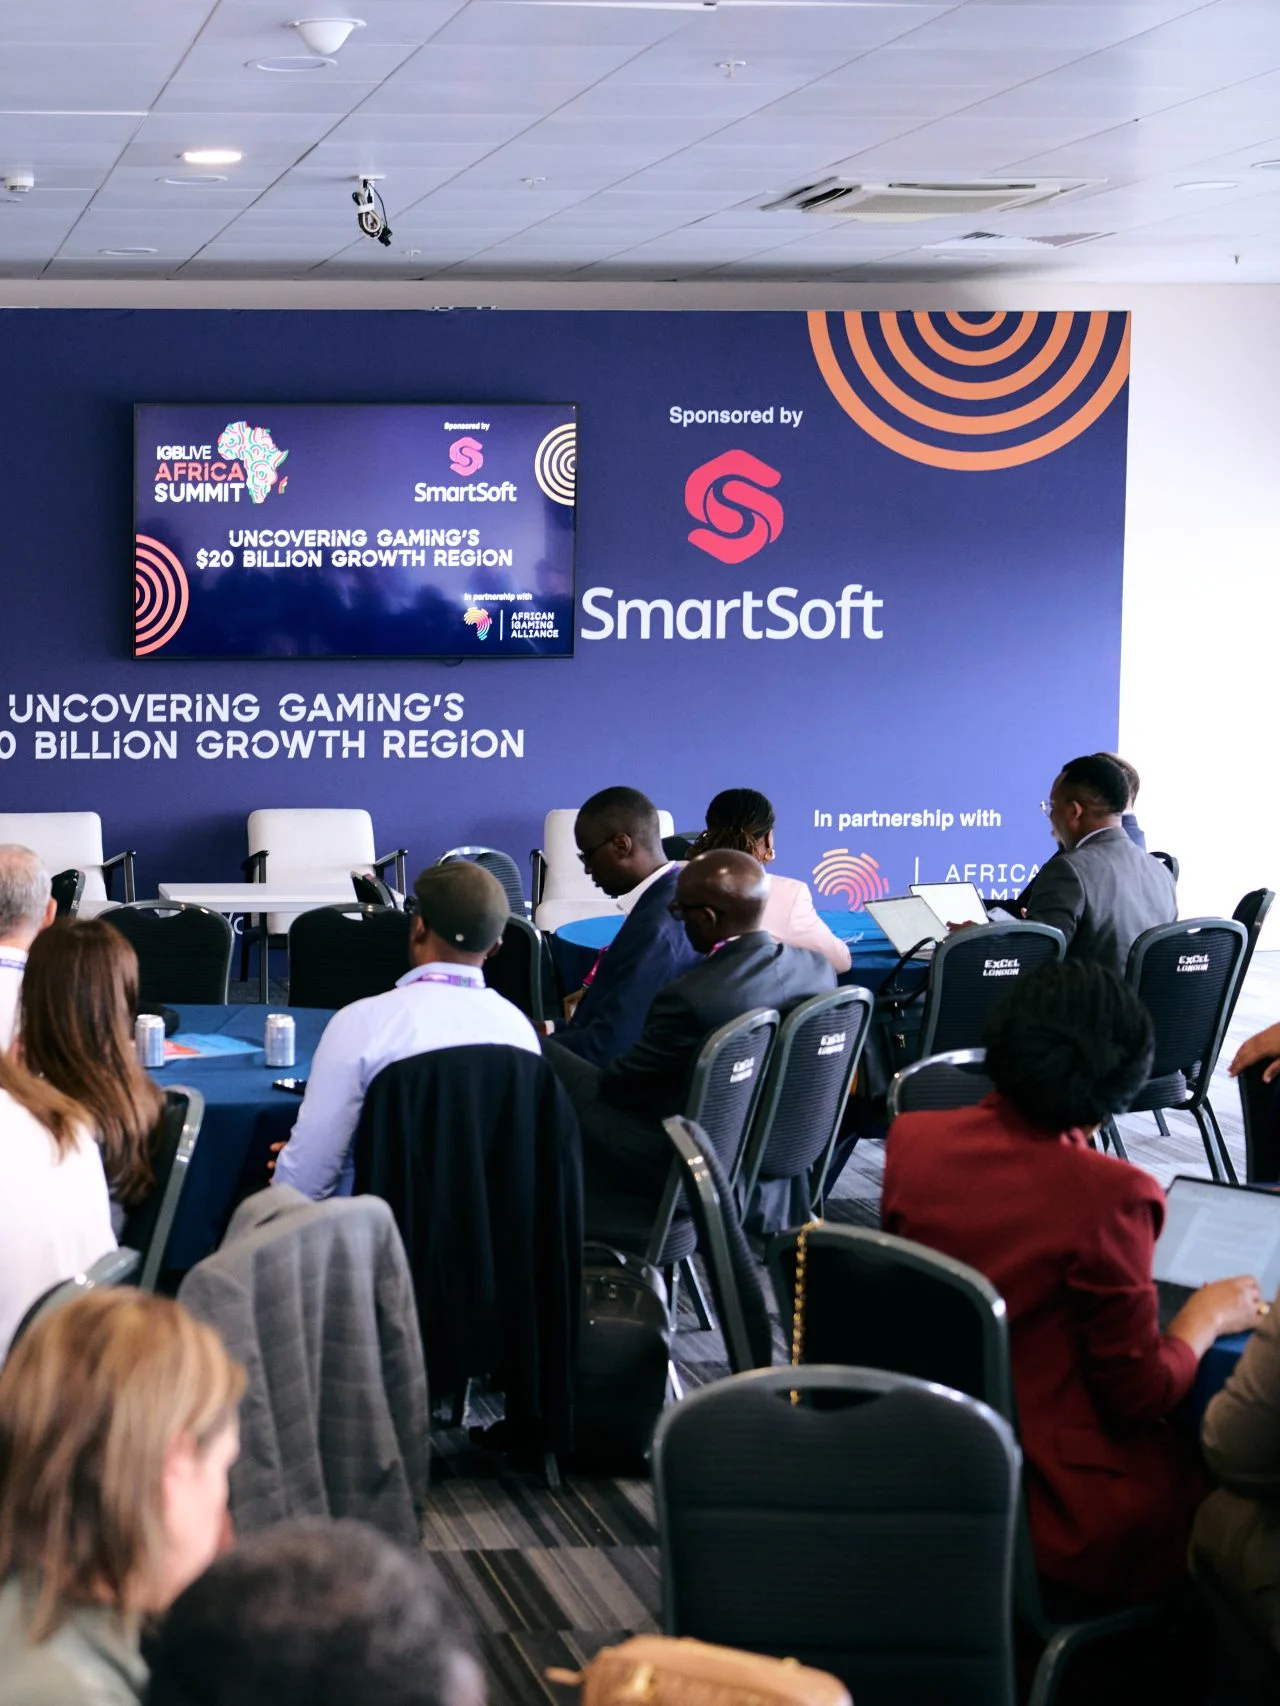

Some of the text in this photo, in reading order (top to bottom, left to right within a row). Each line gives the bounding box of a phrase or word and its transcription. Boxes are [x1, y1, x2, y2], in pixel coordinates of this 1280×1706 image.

[444, 422, 490, 431] Sponsored by
[669, 406, 803, 428] Sponsored by
[154, 462, 245, 482] AFRICA
[154, 482, 245, 503] SUMMIT
[414, 481, 517, 502] SmartSoft
[229, 528, 480, 547] UNCOVERING GAMING'S
[196, 548, 513, 569] $20 BILLION GROWTH REGION
[473, 593, 515, 602] partnership
[516, 592, 533, 600] with
[511, 612, 555, 620] AFRICAN
[581, 584, 884, 640] SmartSoft
[511, 629, 559, 638] ALLIANCE
[8, 693, 261, 723] UNCOVERING
[35, 730, 177, 760] BILLION
[195, 729, 366, 759] GROWTH
[383, 729, 524, 759] REGION
[814, 809, 1001, 831] In partnership with
[945, 863, 1040, 883] AFRICA
[982, 968, 1020, 976] LONDON
